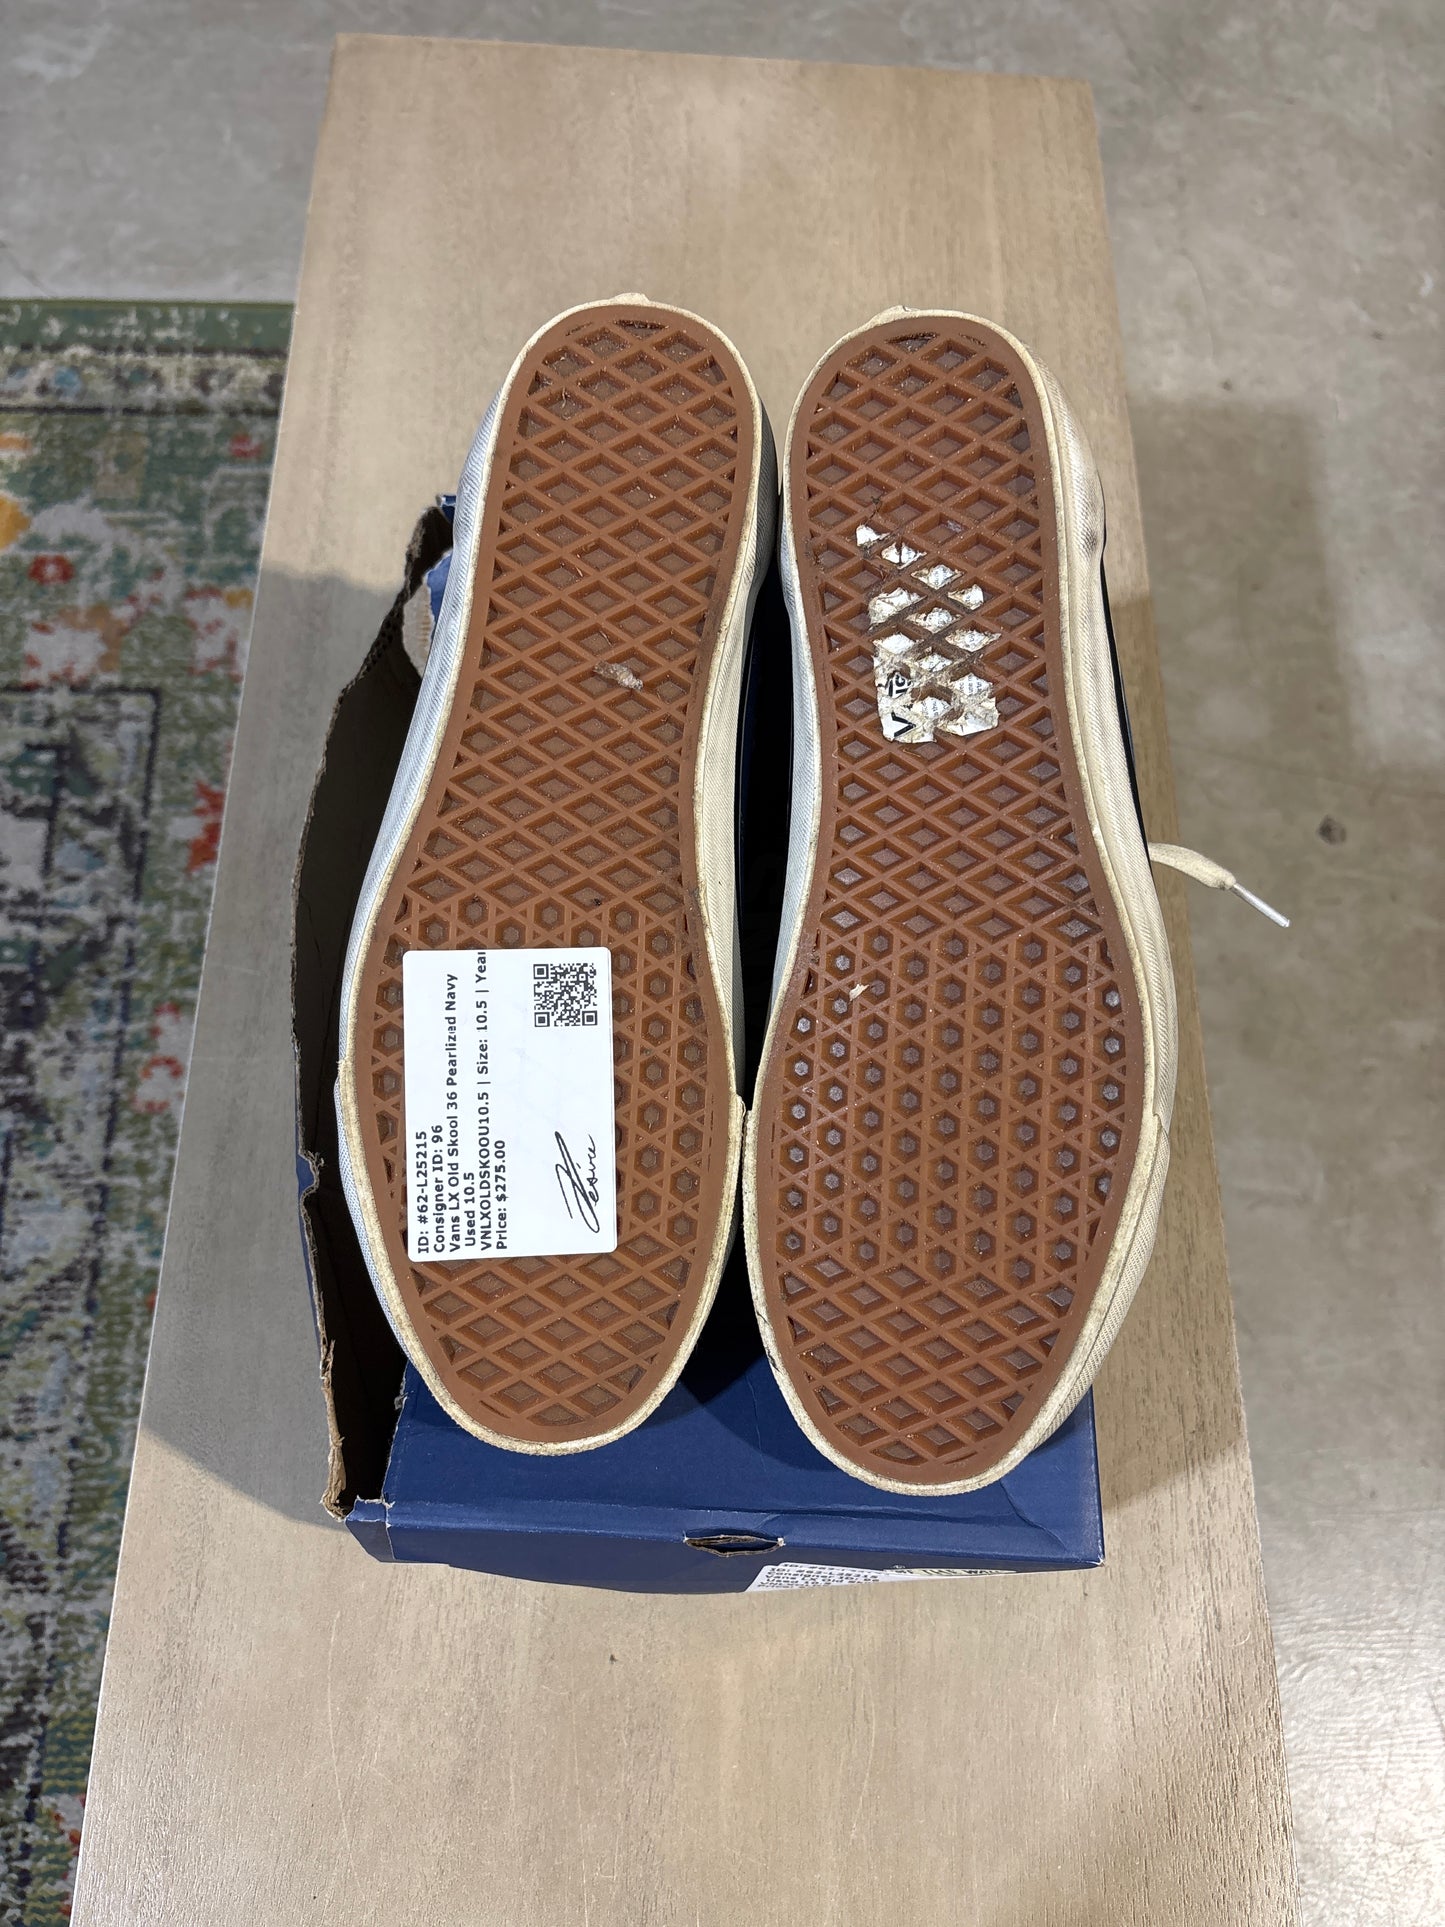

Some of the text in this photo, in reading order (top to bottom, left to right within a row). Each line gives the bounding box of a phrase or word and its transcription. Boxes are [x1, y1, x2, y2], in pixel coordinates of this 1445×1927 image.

[476, 1001, 487, 1031] 10.5
[477, 1040, 488, 1074] Size:
[445, 974, 460, 1252] Vans LX Old Skool 36 Pearlized Navy
[416, 1132, 429, 1253] ID: #62-L25215
[431, 1125, 447, 1252] Consigner ID: 96
[464, 1173, 475, 1246] Used 10.5
[494, 1140, 508, 1249] Price: $275.00
